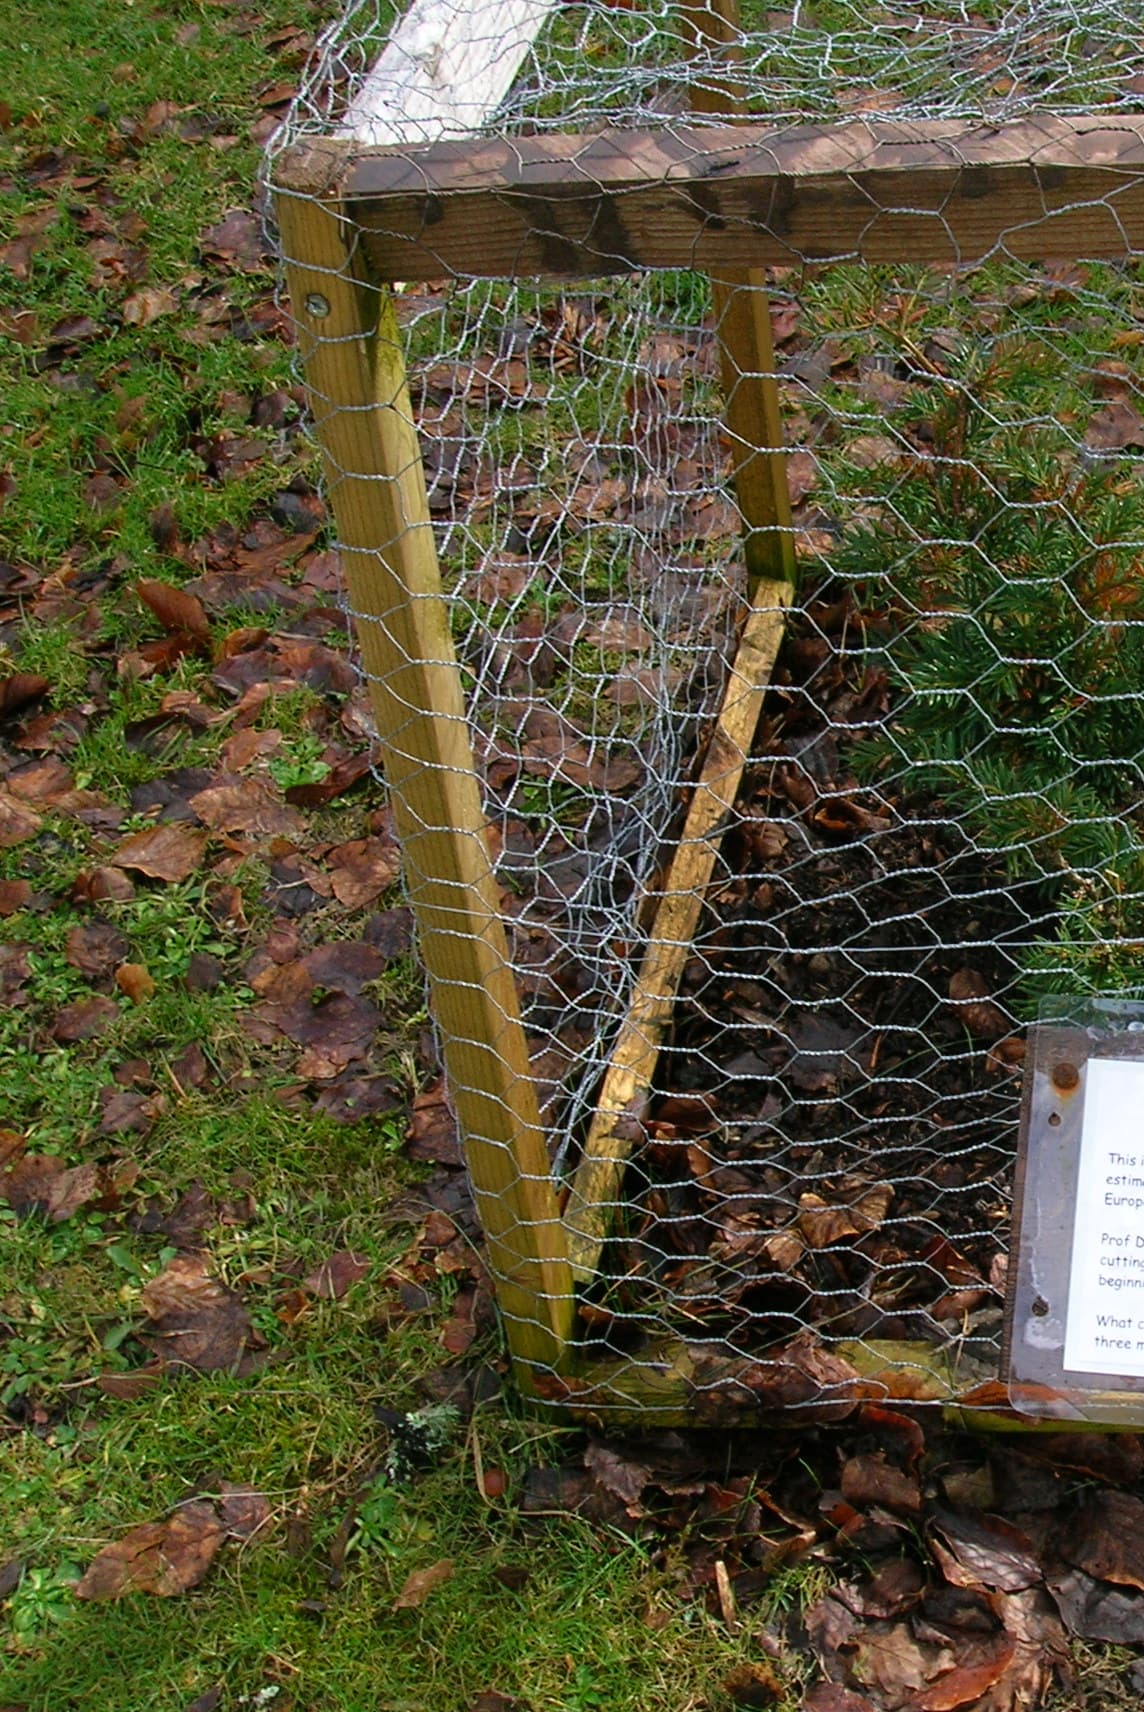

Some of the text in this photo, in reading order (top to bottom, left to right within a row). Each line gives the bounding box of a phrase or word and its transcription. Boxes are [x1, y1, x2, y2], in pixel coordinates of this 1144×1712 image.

[1108, 1152, 1136, 1166] This
[1101, 1232, 1130, 1247] Prof
[1096, 1315, 1132, 1328] What
[1095, 1336, 1131, 1349] three
